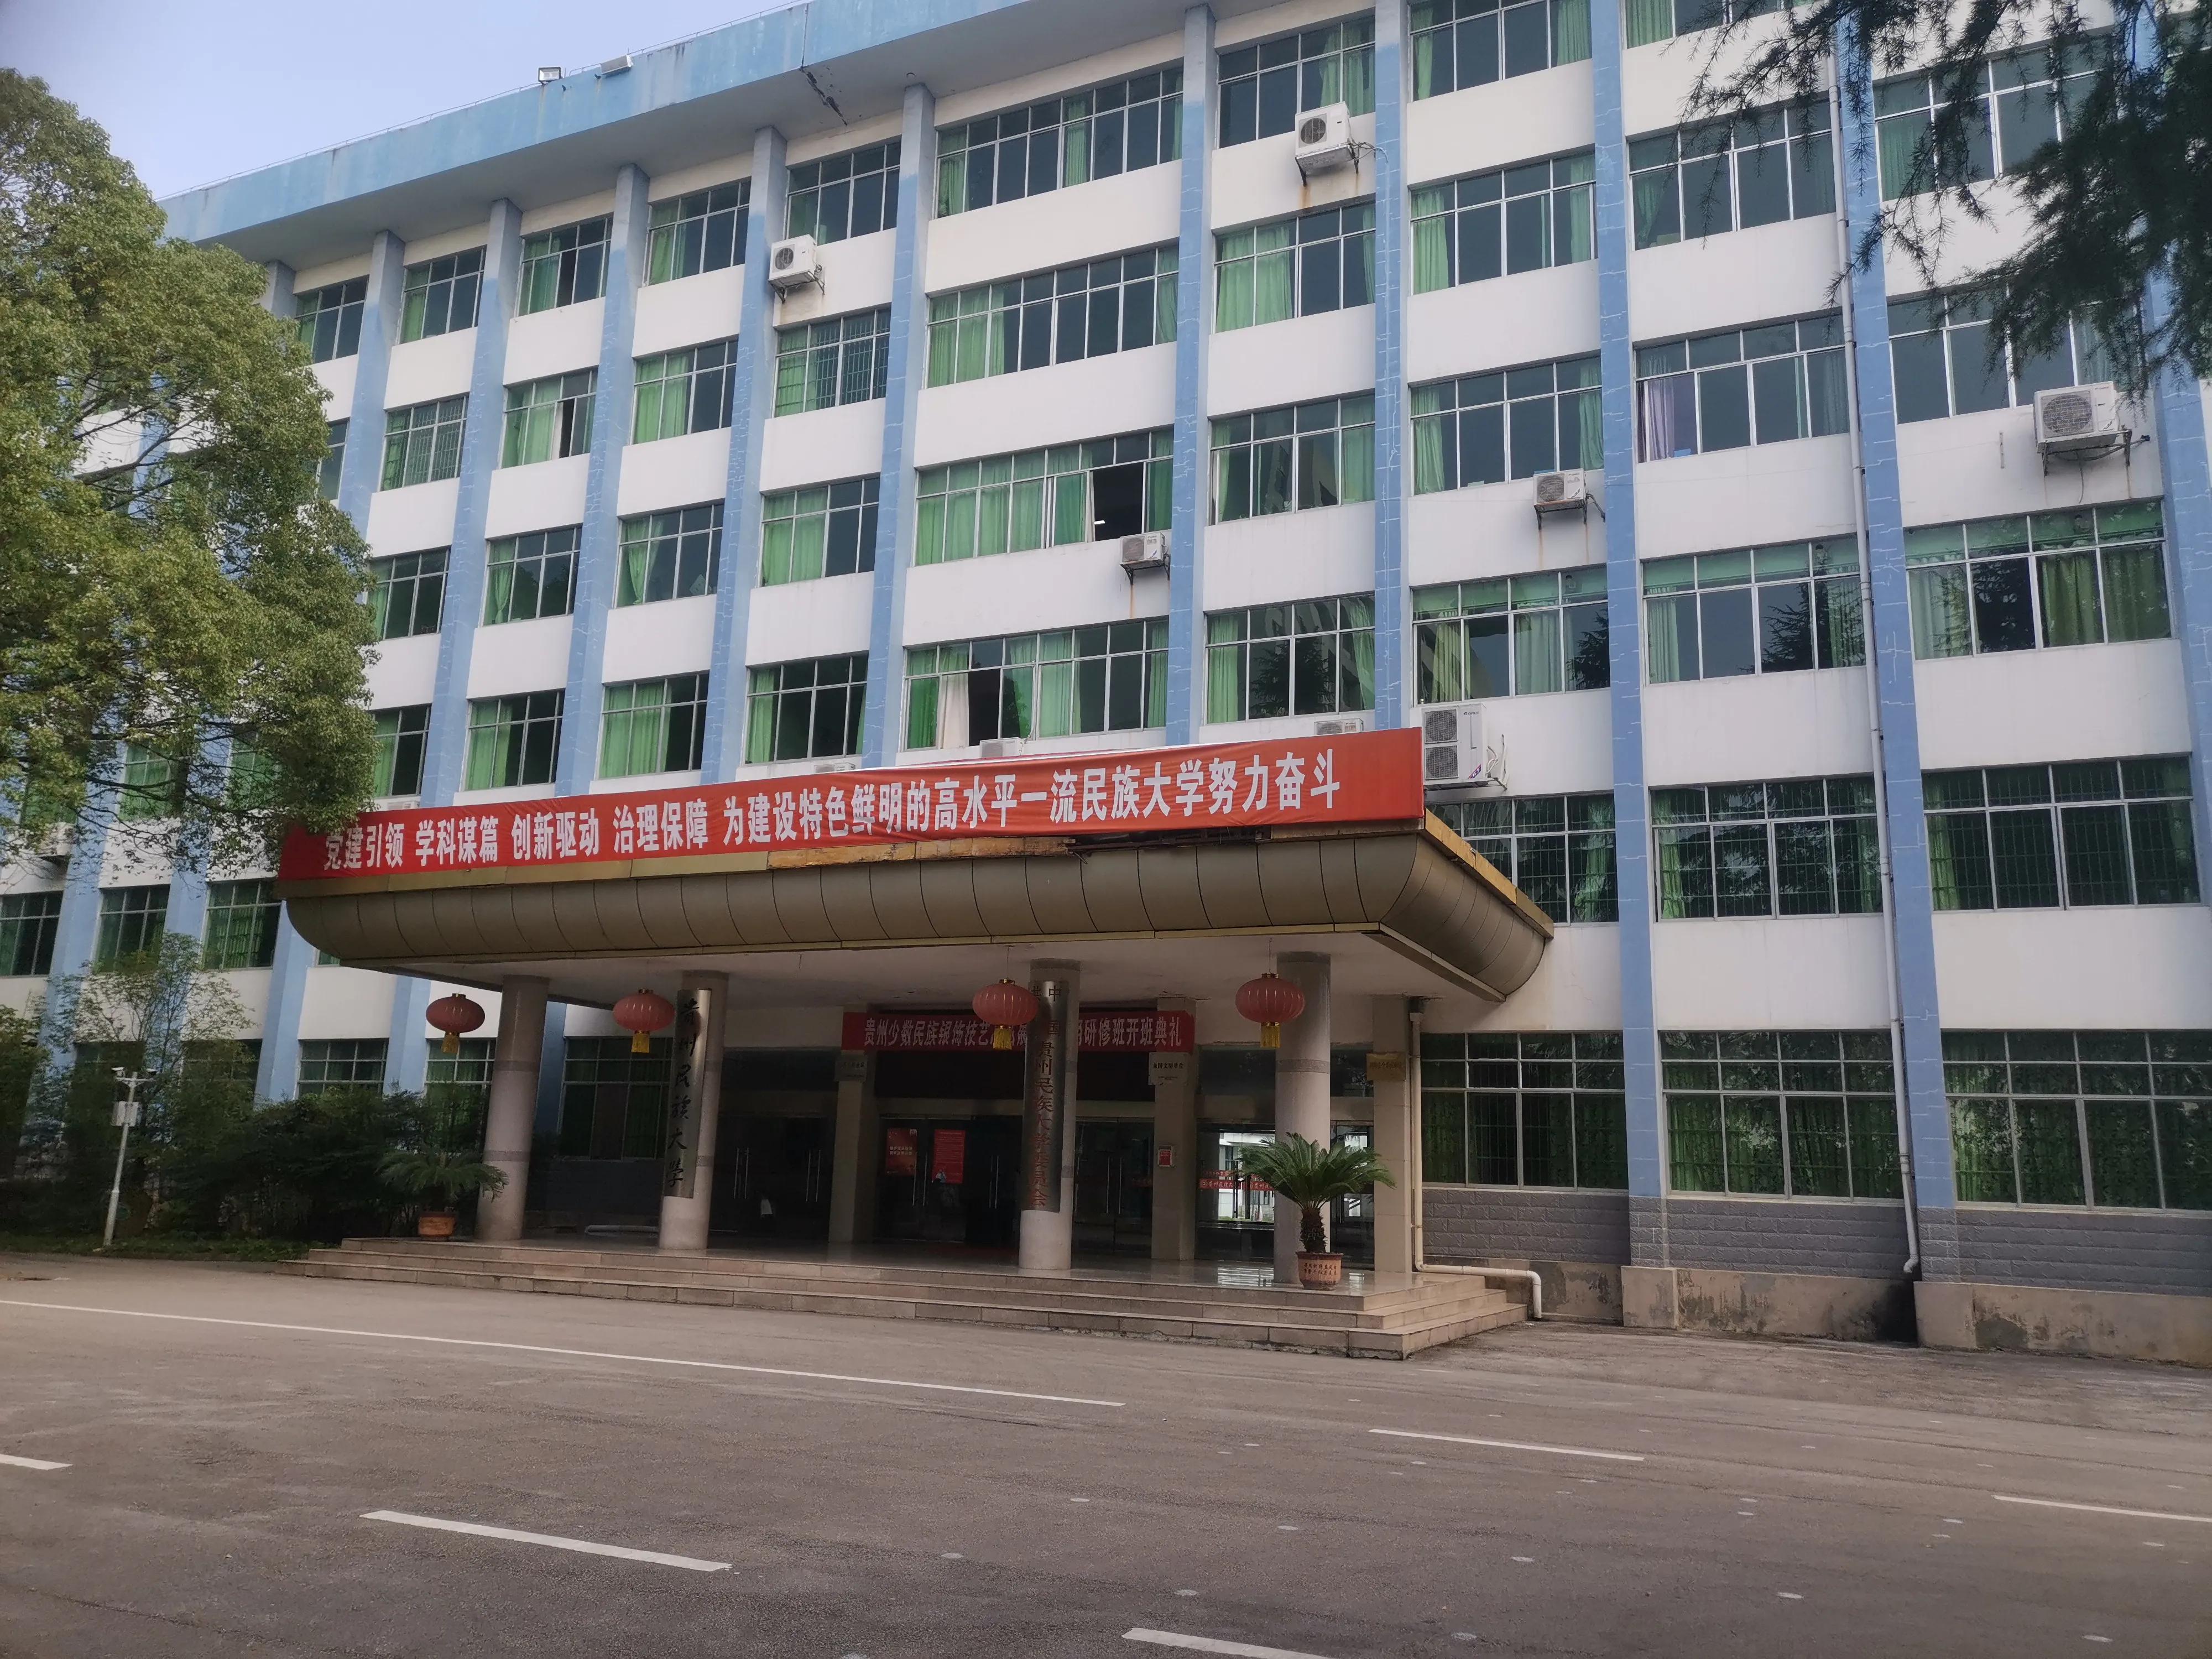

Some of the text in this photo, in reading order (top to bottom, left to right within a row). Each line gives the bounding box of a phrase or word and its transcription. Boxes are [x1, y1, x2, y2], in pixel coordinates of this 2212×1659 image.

[324, 748, 1340, 870] 党建引领 学科谋篇 创新驱动 治理保障 为建设特色鲜明的高水平一流民族大学努力奋斗
